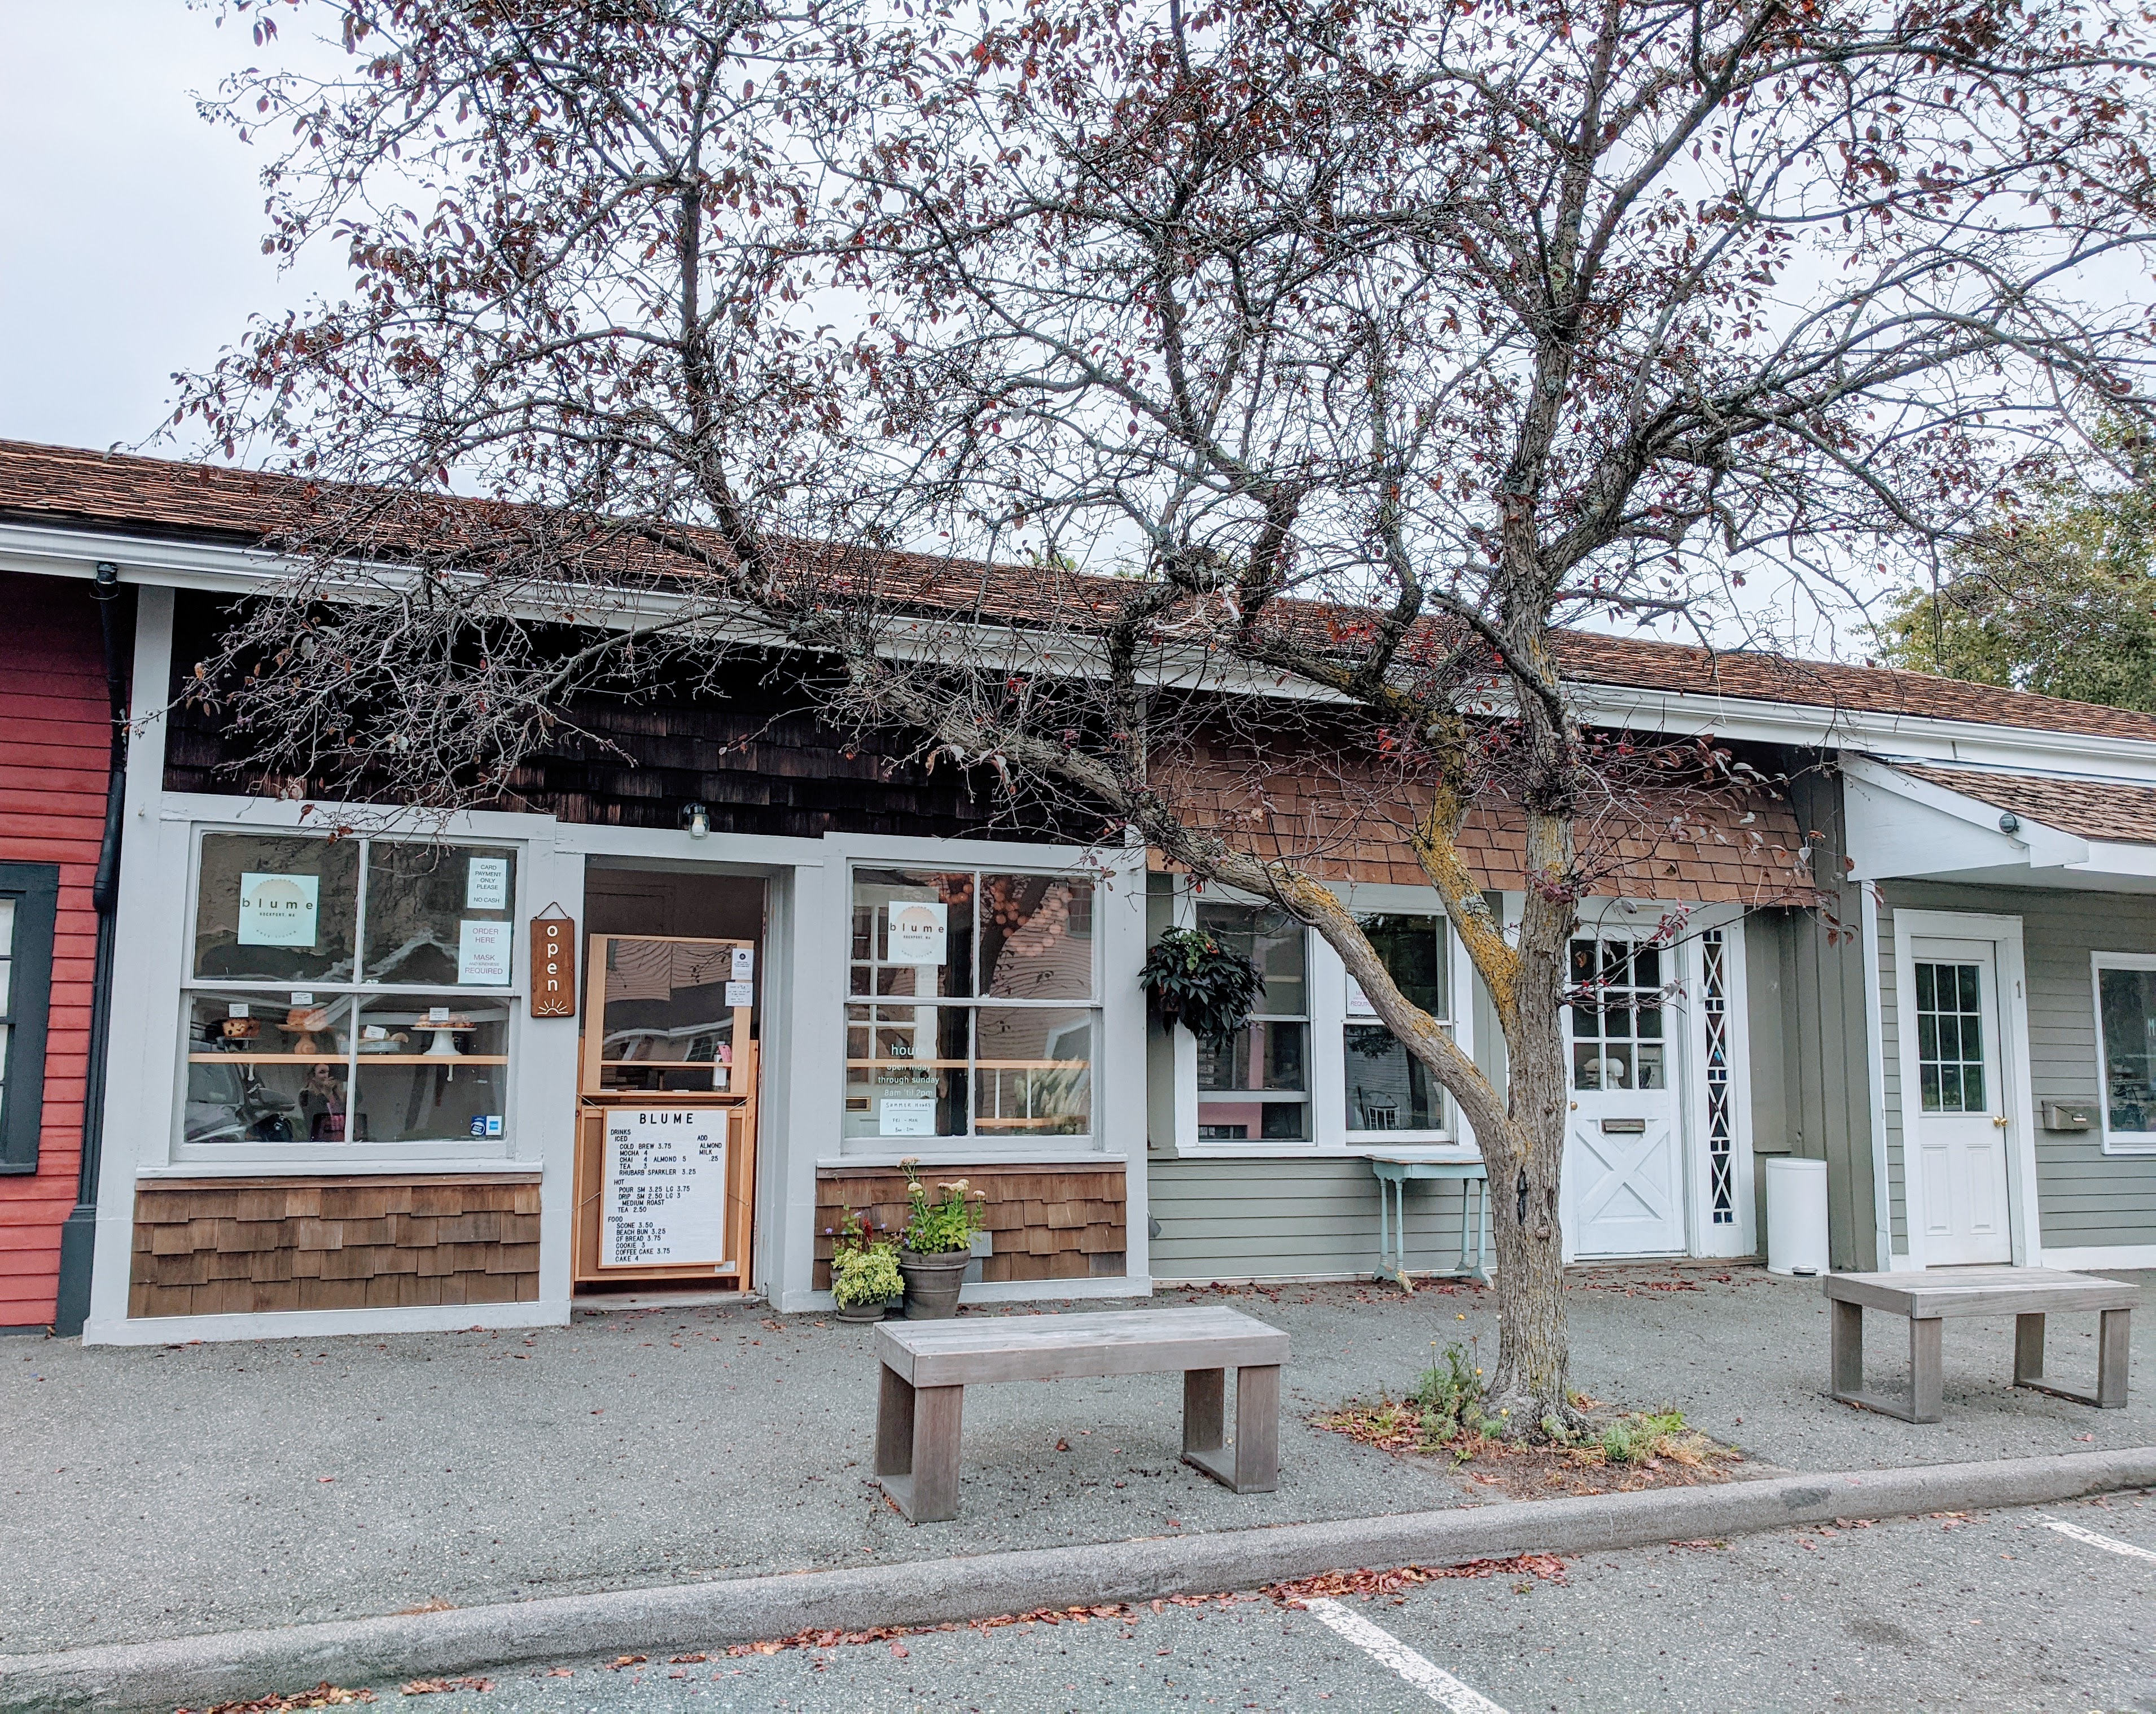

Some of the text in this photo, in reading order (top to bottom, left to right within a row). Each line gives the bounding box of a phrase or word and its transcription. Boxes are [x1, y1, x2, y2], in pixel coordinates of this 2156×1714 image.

[242, 898, 313, 910] blume
[890, 922, 944, 933] blume
[547, 925, 559, 991] open
[909, 1063, 931, 1072] friday
[878, 1075, 940, 1085] through sunday
[639, 1113, 693, 1124] BLUME
